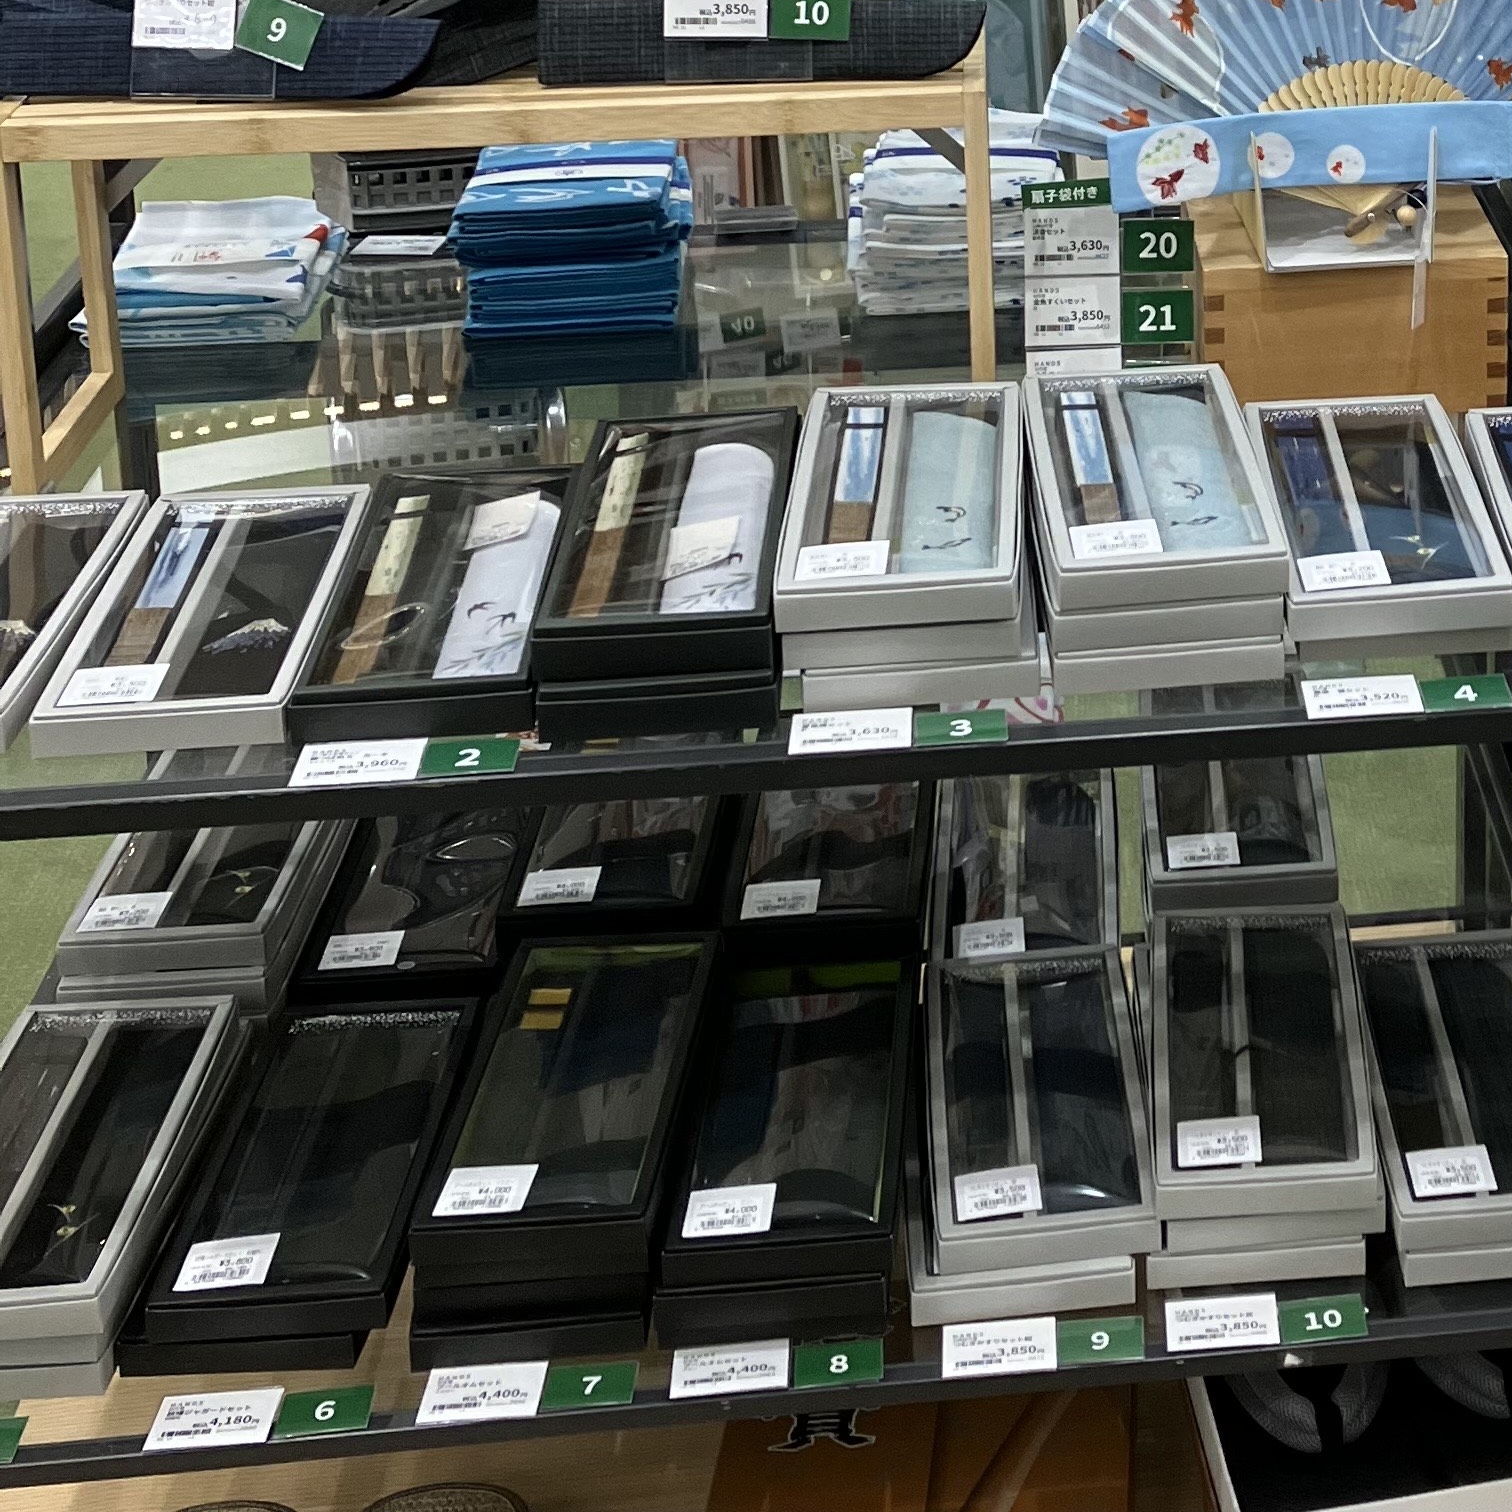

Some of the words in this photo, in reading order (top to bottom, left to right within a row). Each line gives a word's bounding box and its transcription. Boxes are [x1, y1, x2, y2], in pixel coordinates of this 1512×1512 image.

[794, 0, 830, 25] 10
[267, 17, 287, 42] 9
[1139, 231, 1178, 259] 20
[1138, 304, 1177, 332] 21
[1454, 685, 1478, 702] 4
[949, 718, 973, 736] 3
[454, 748, 481, 767] 2
[1304, 1309, 1342, 1331] 10
[1090, 1332, 1110, 1350] 9
[830, 1355, 849, 1373] 8
[582, 1375, 602, 1396] 7
[314, 1400, 336, 1421] 6
